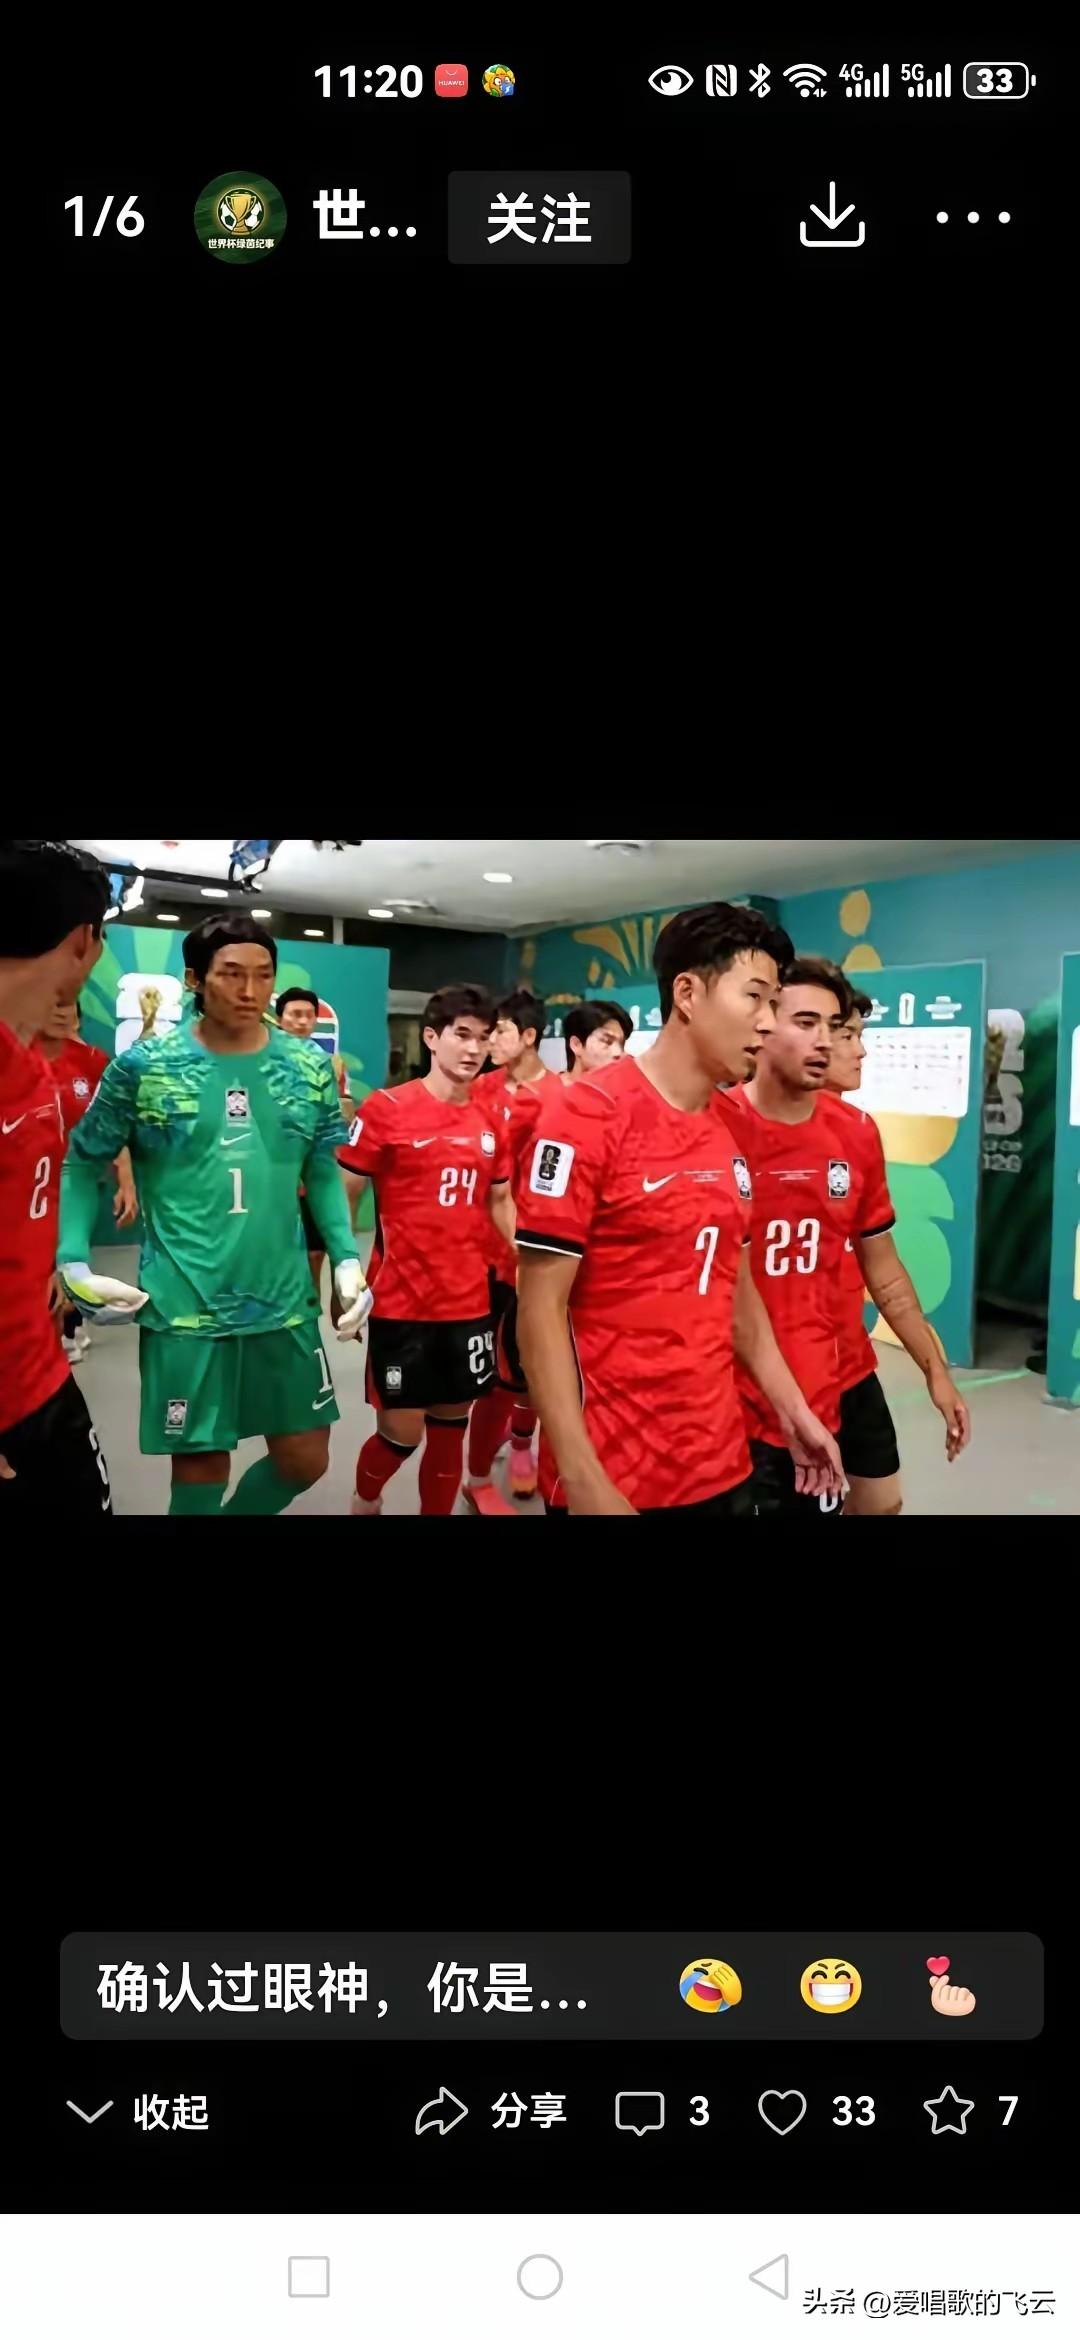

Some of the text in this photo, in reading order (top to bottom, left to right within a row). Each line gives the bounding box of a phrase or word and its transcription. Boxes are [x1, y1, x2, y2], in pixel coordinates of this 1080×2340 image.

[315, 65, 422, 98] 11:20
[839, 64, 864, 81] 4G
[901, 64, 924, 81] 5G
[976, 68, 1013, 93] 33
[64, 196, 145, 238] 1/6
[487, 192, 592, 244] 关注
[208, 239, 274, 249] 世界杯绿茵纪事
[30, 1156, 50, 1219] 2
[227, 1168, 248, 1213] 1
[439, 1167, 477, 1206] 24
[695, 1226, 719, 1295] 7
[765, 1218, 820, 1276] 23
[314, 1348, 333, 1393] 1
[133, 2094, 209, 2131] 收起
[490, 2092, 567, 2129] 分享
[689, 2096, 710, 2127] 3
[832, 2096, 876, 2127] 33
[998, 2096, 1019, 2126] 7
